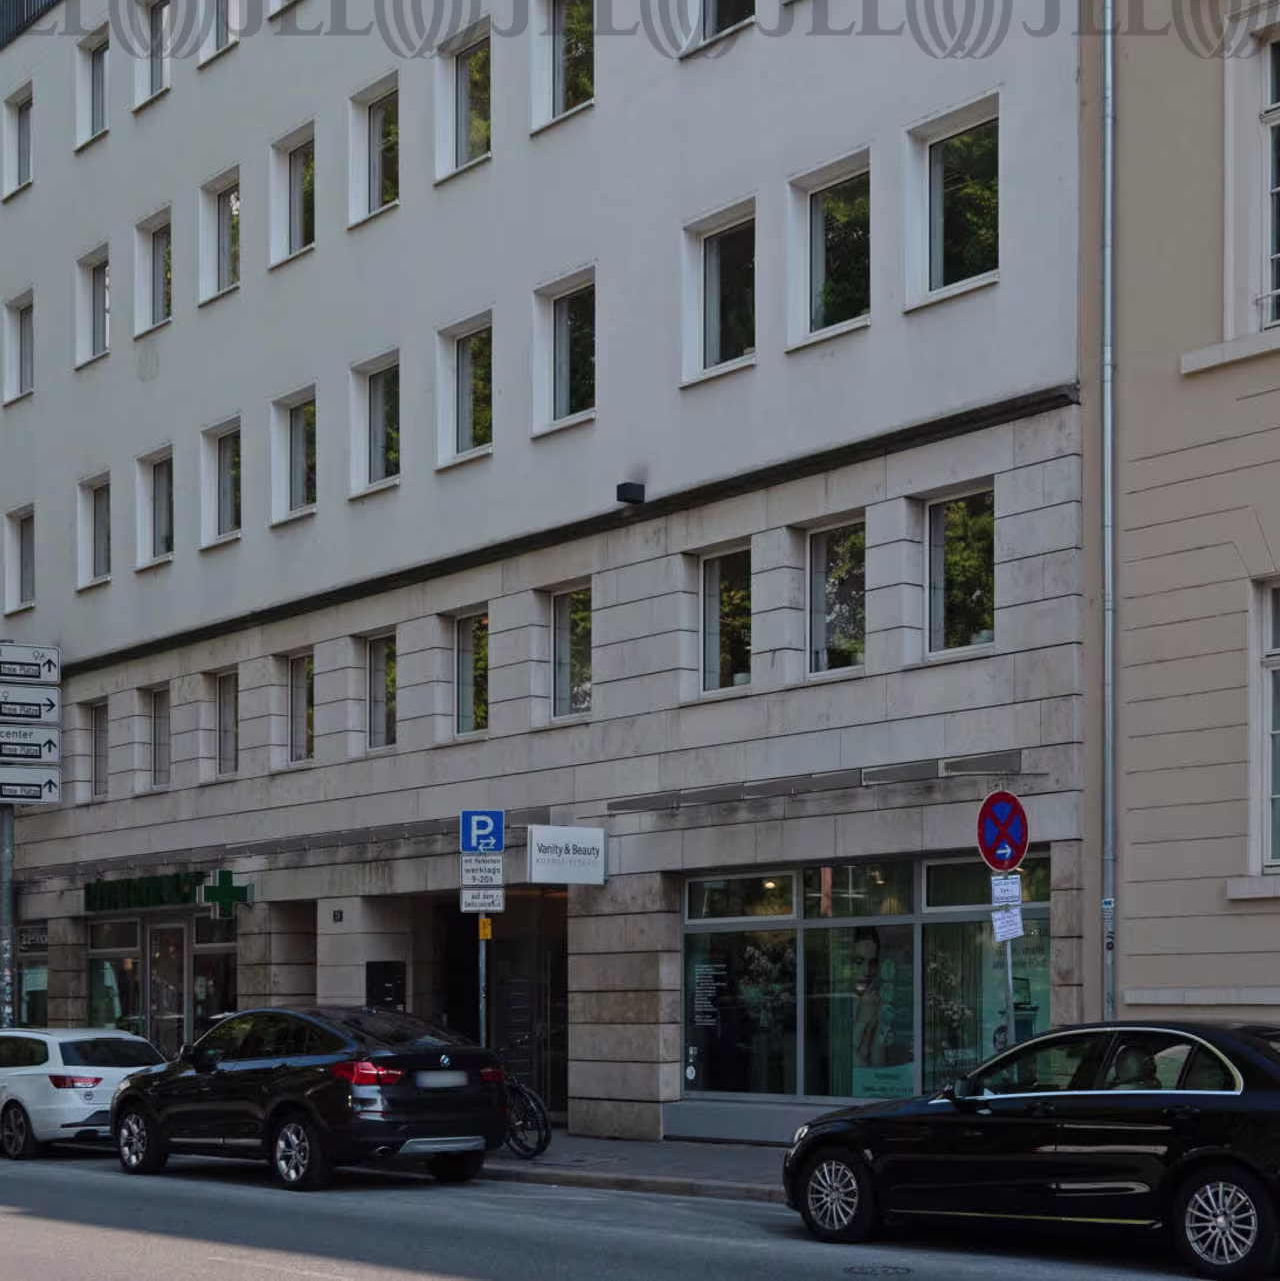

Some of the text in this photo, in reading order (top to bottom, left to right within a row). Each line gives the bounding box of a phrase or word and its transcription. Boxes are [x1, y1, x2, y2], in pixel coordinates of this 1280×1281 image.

[470, 815, 495, 848] P
[536, 842, 600, 859] Vanity & Beauty
[464, 866, 501, 875] werktags
